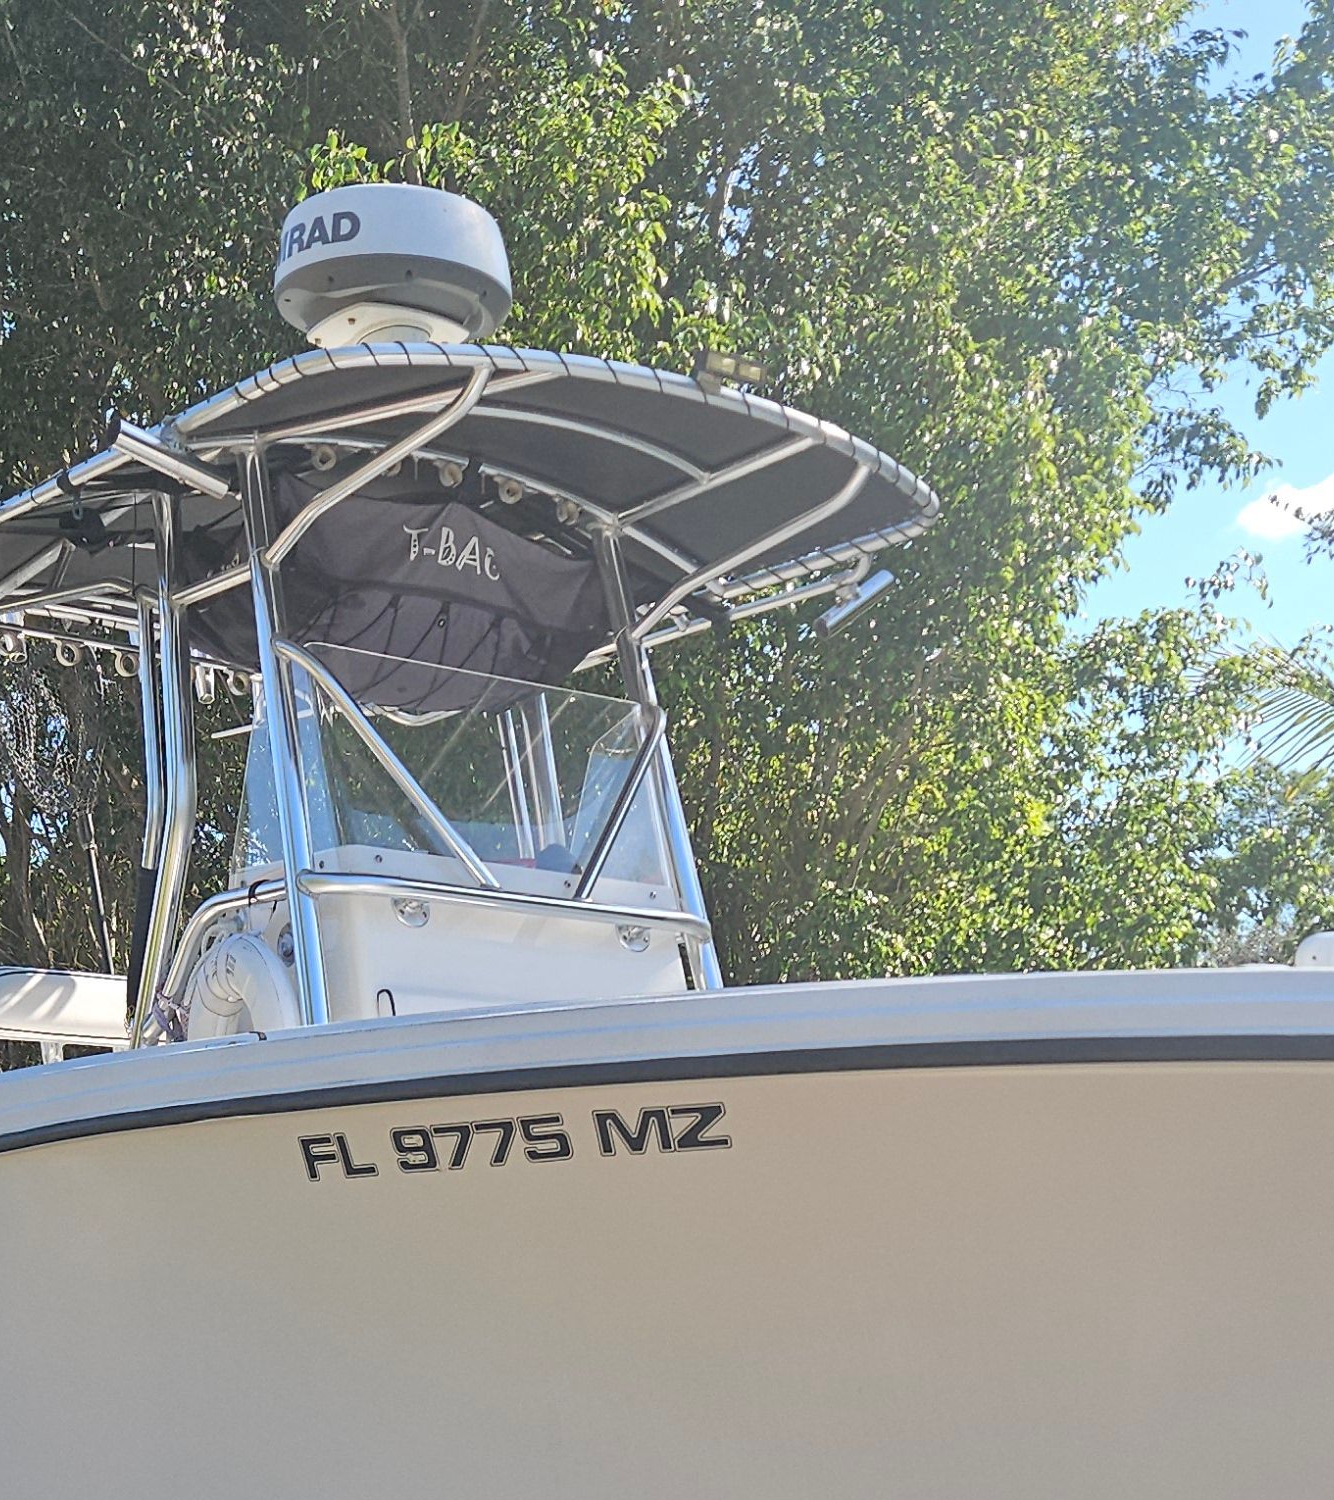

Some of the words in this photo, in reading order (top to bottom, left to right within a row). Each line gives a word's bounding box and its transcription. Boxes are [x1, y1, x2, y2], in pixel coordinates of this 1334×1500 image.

[298, 1132, 379, 1182] FL
[390, 1112, 574, 1173] 9775
[592, 1101, 733, 1157] MZ
